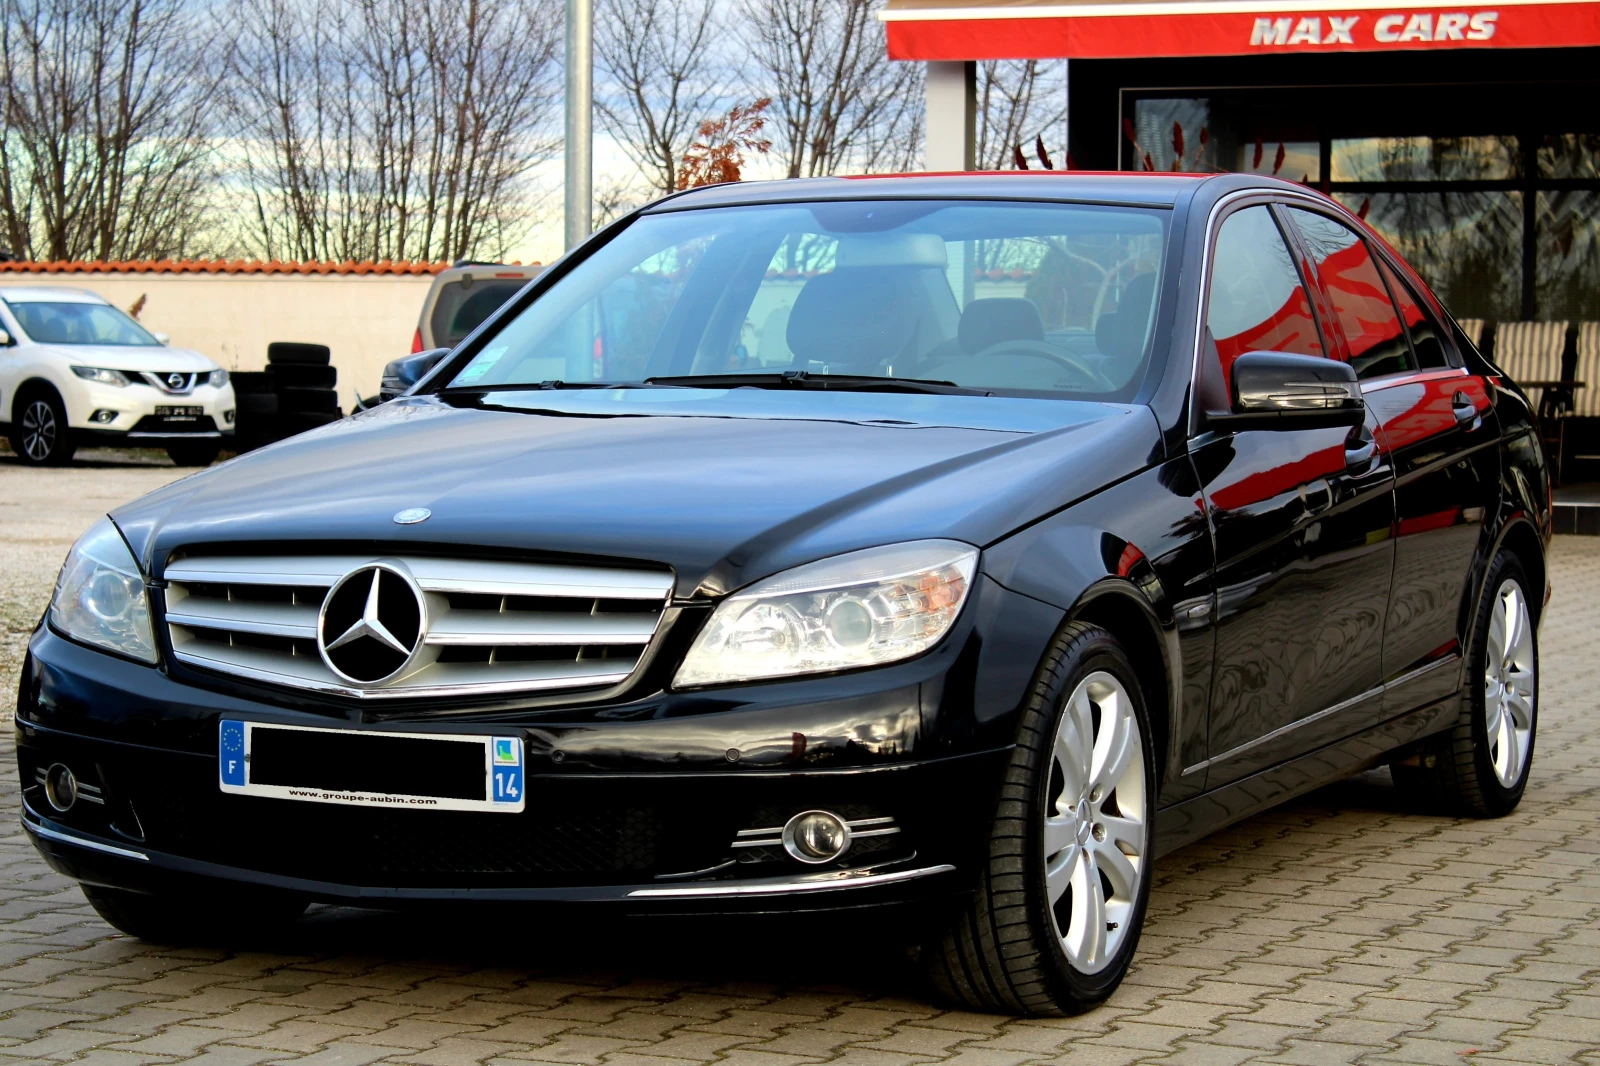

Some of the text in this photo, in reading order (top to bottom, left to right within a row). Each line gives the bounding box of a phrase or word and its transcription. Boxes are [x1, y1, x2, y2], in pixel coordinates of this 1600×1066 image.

[1250, 12, 1499, 45] MAX CARS
[228, 760, 237, 774] F
[495, 772, 519, 798] 14
[288, 789, 438, 805] www.groupe-aubin.com
